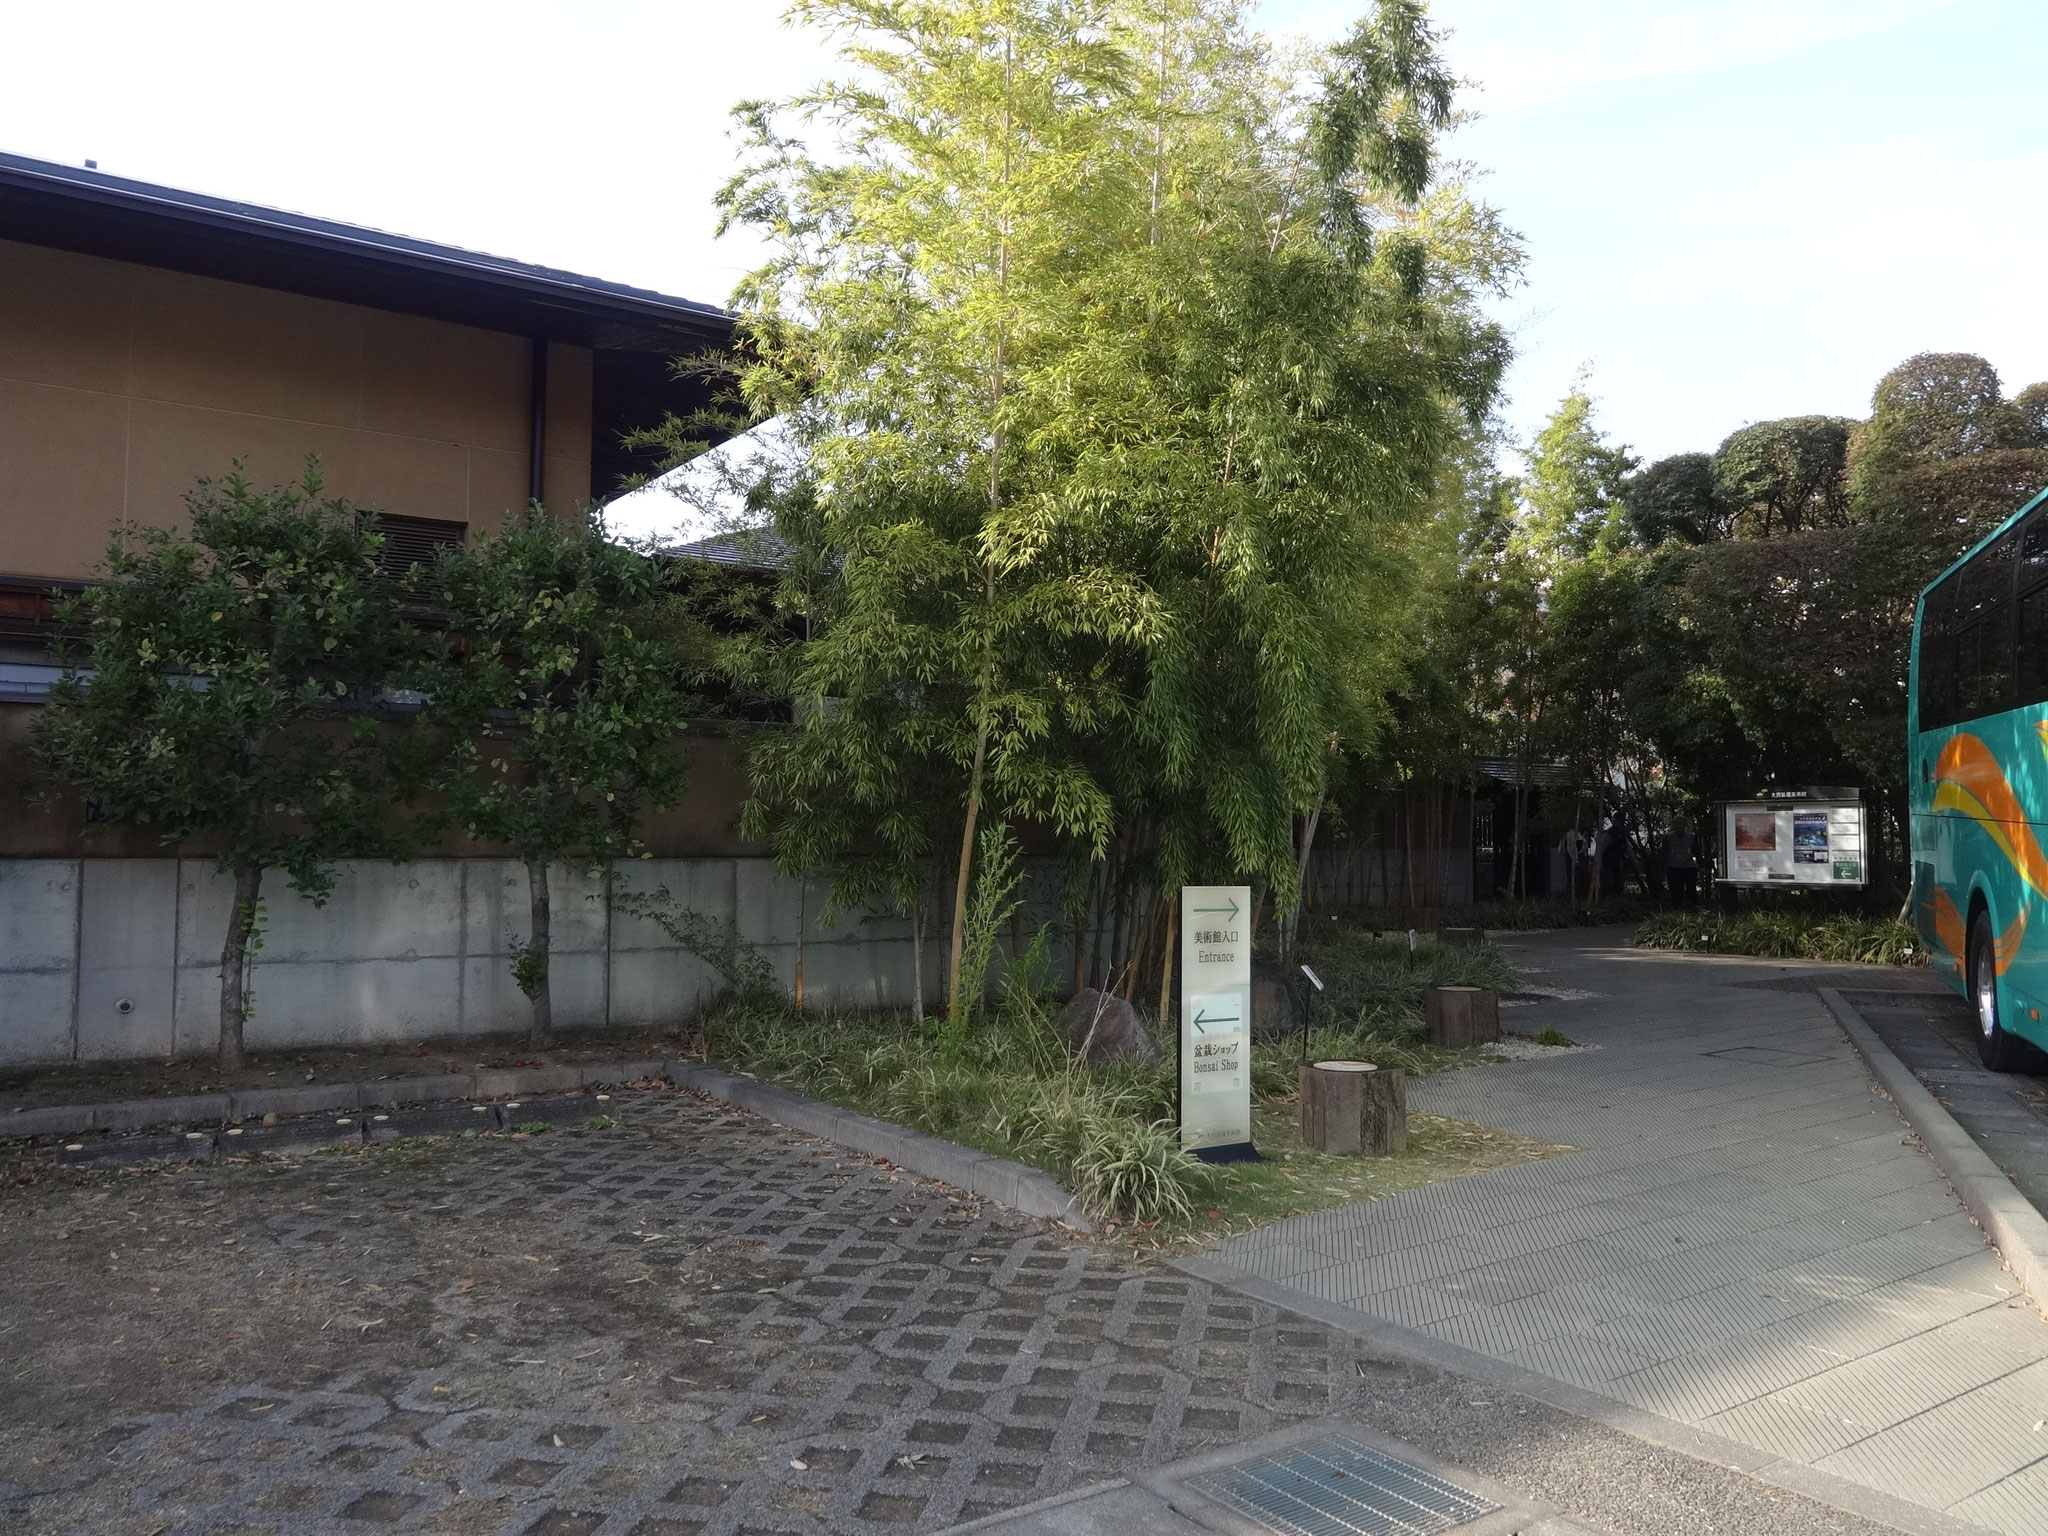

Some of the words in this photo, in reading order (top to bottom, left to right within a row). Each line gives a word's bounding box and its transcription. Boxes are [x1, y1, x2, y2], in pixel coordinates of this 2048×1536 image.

[1194, 930, 1239, 944] 美術館入口
[1198, 950, 1235, 963] Entrance
[1193, 1041, 1239, 1058] 盆栽ショップ
[1193, 1060, 1219, 1074] Bonsai
[1221, 1058, 1239, 1071] Shop
